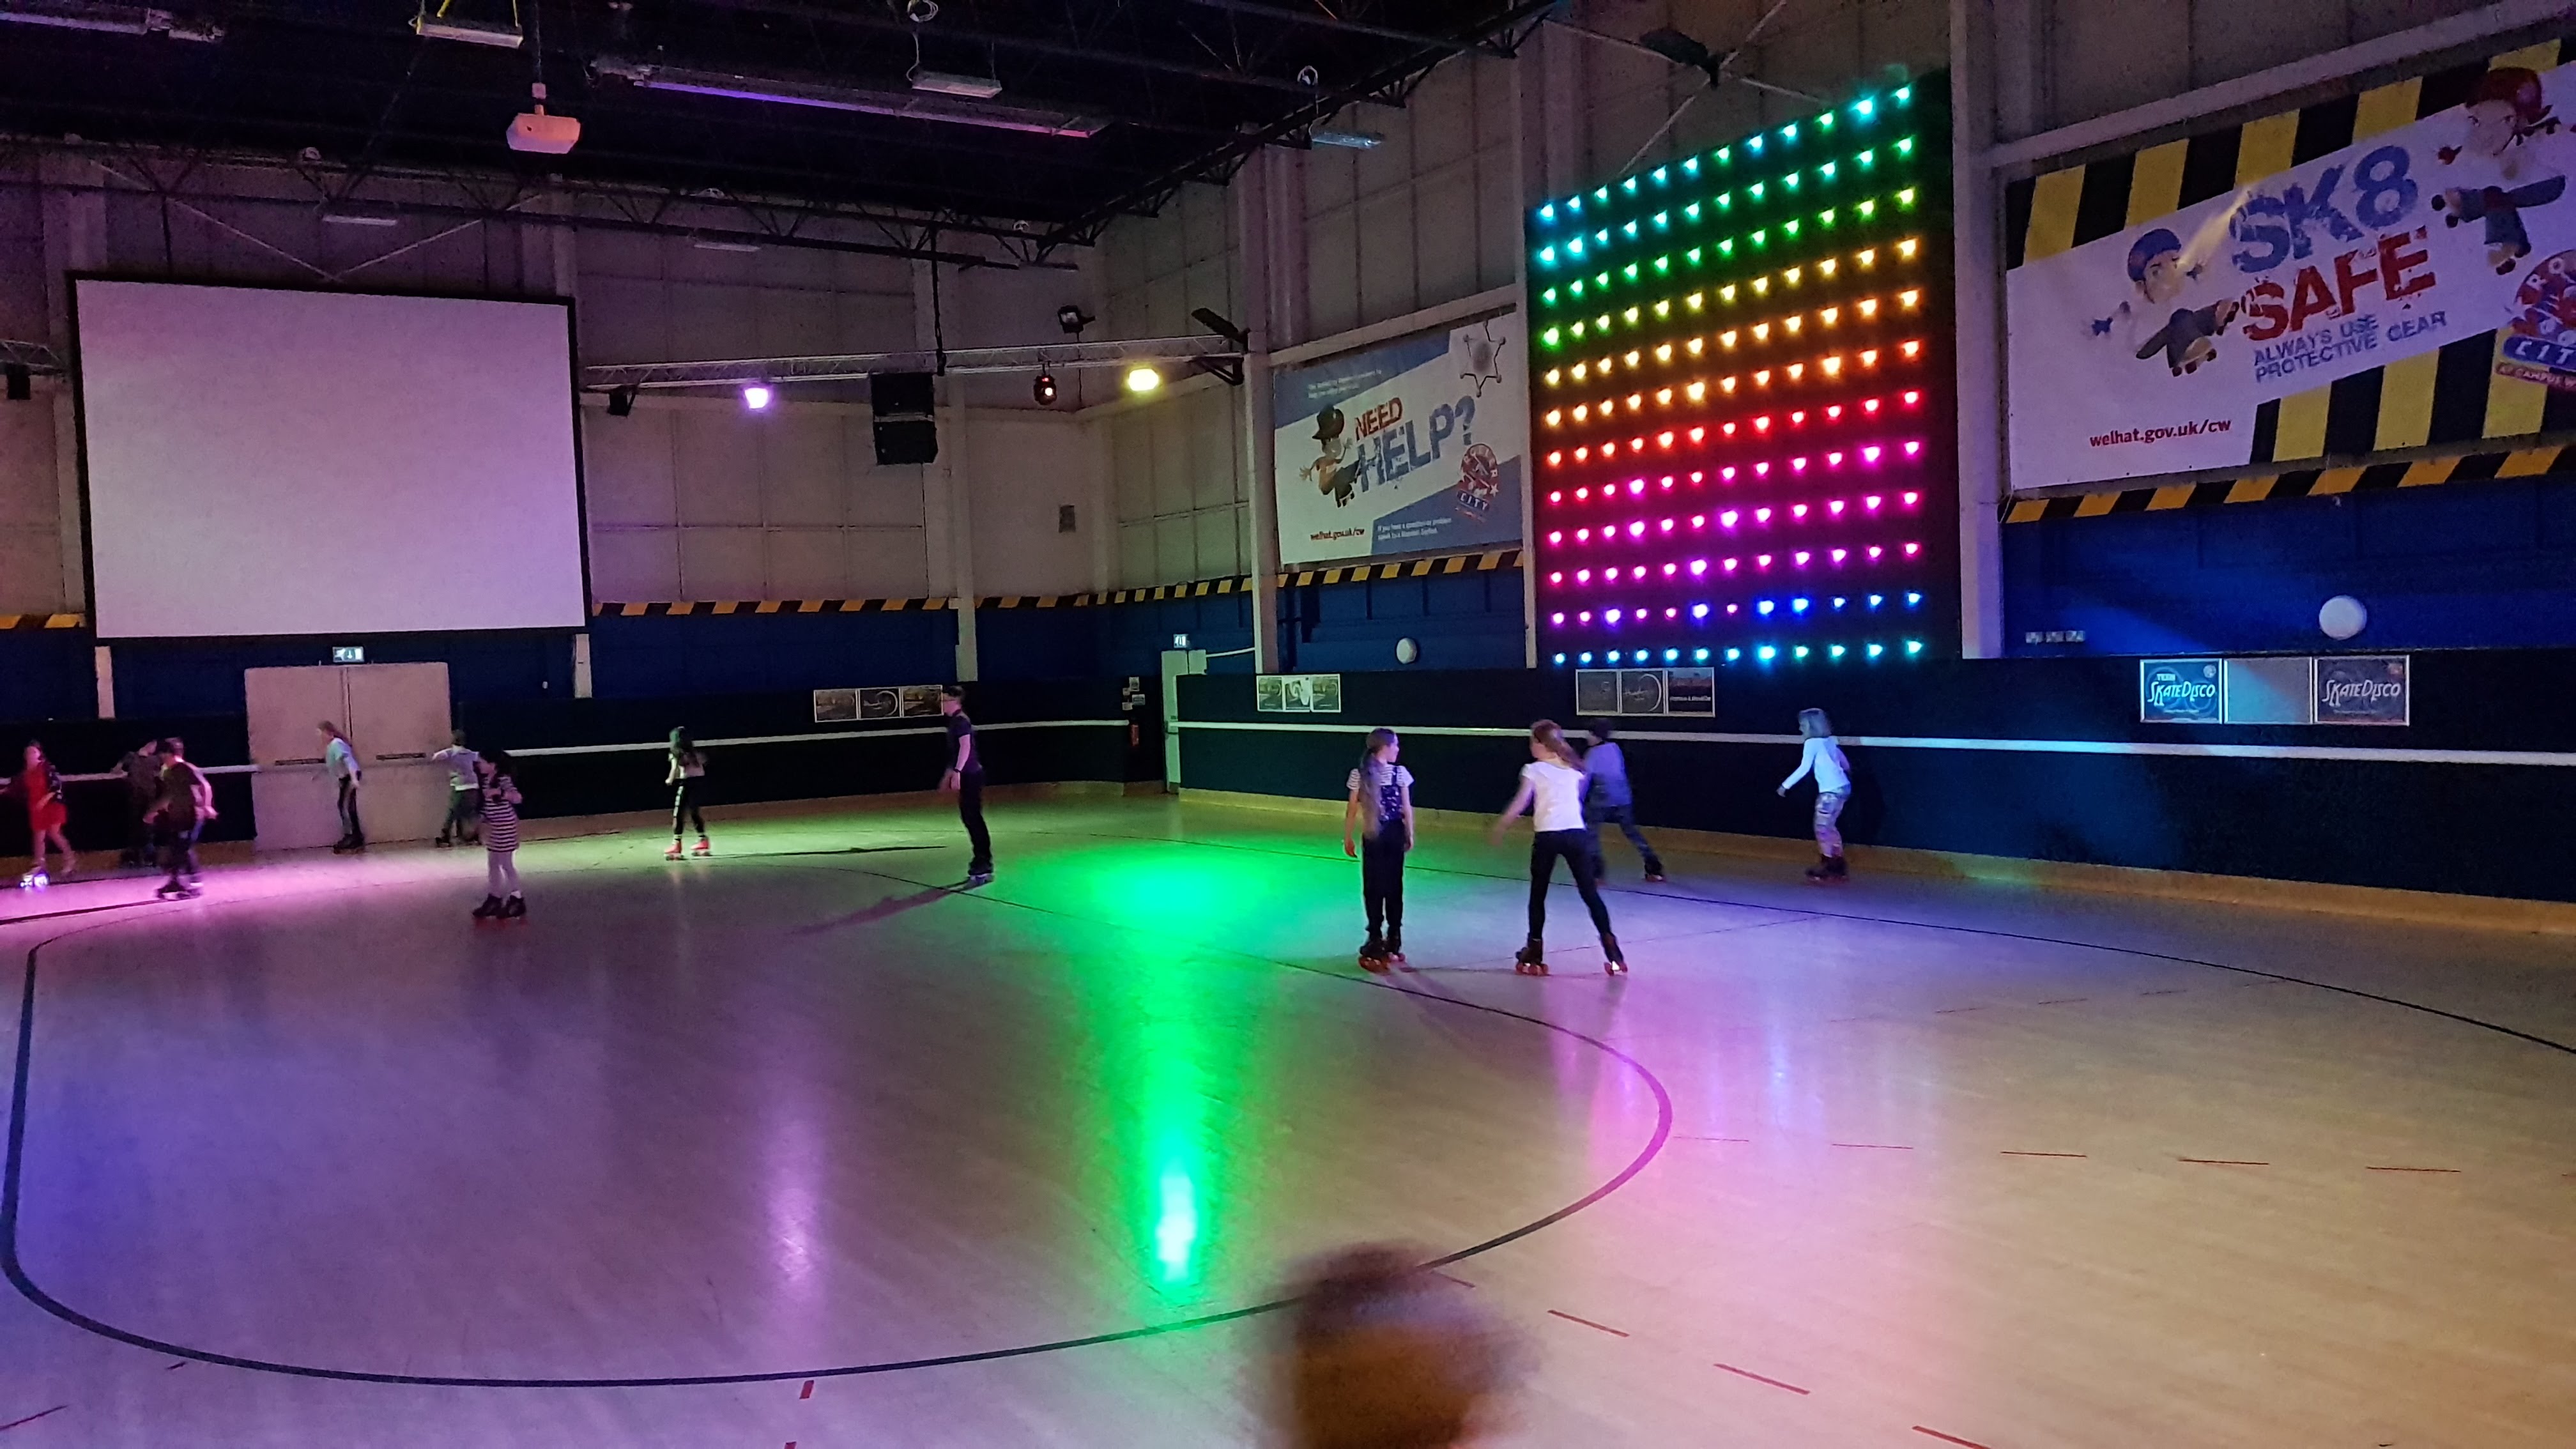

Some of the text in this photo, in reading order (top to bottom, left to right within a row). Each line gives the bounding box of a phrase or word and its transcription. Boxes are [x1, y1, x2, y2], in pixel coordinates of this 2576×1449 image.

[2229, 145, 2418, 273] SK8
[2241, 226, 2436, 341] SAFE
[2254, 314, 2379, 366] ALWAYS USE
[2255, 311, 2447, 383] PROTECTIVE GEAR
[1355, 397, 1403, 441] NEED
[1358, 395, 1476, 493] HELP?
[2089, 419, 2232, 447] welhat.gov.uk/cw
[1460, 493, 1488, 510] CITY
